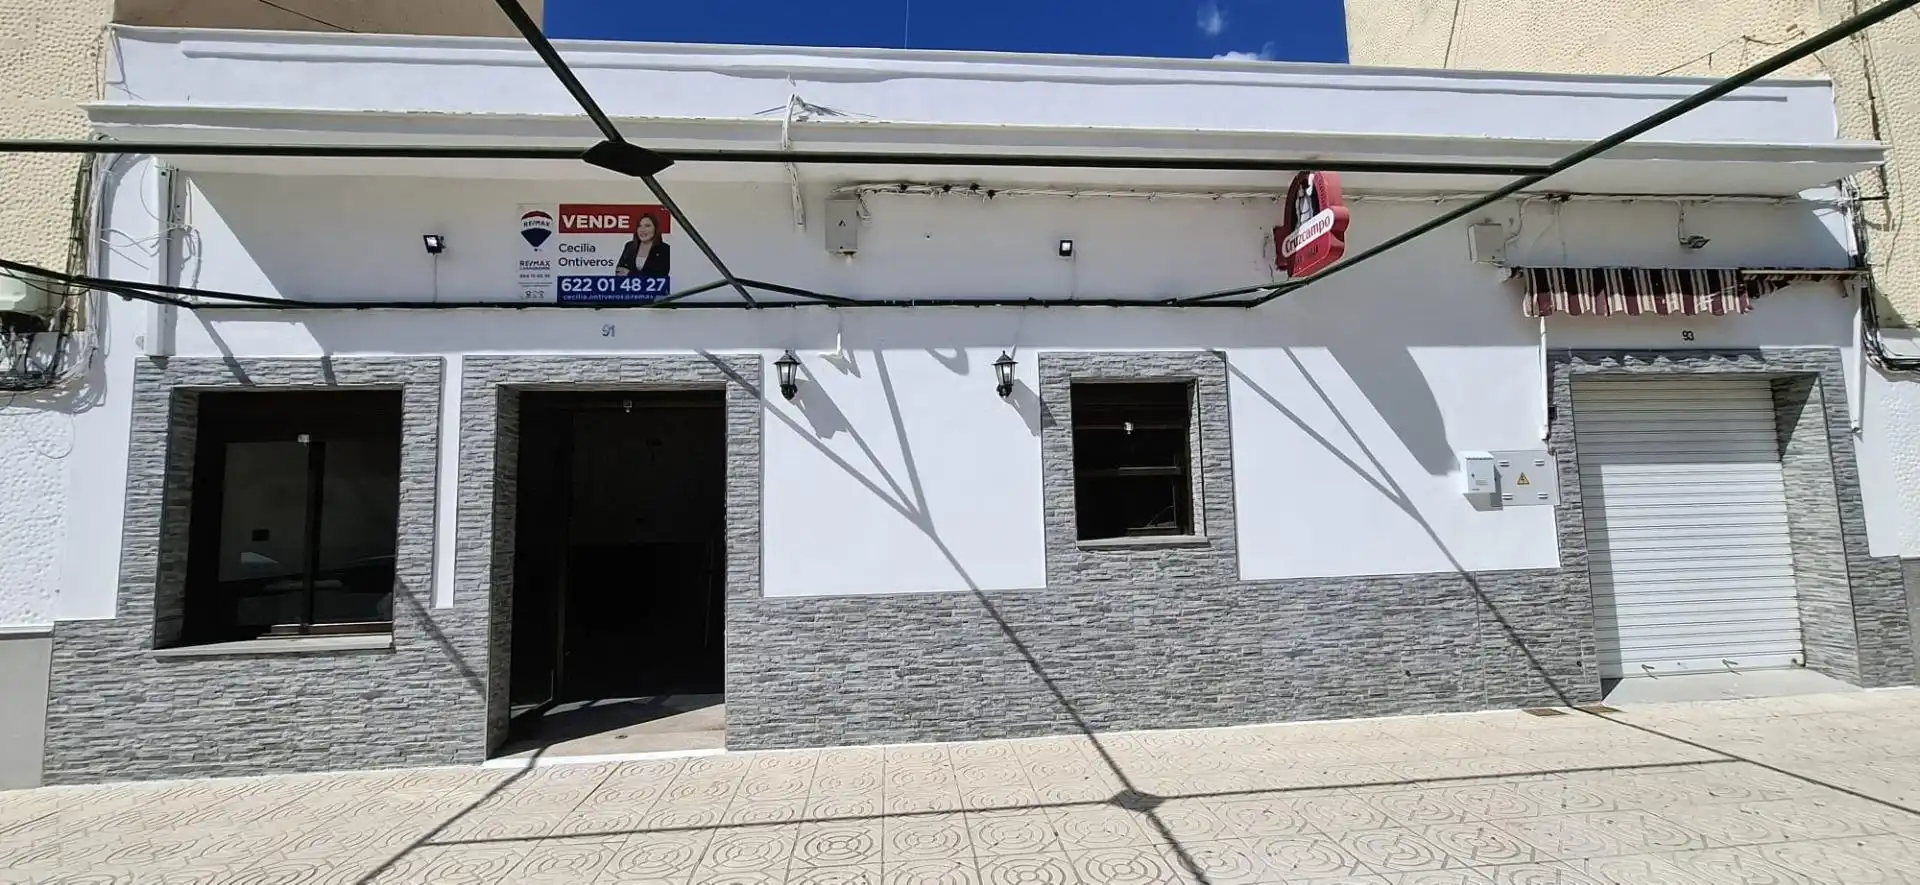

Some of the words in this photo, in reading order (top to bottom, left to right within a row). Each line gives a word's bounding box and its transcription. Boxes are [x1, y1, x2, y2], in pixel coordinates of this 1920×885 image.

[523, 220, 551, 228] RE/MAX
[561, 214, 630, 229] VENDE
[1285, 215, 1331, 253] Cruzcampo
[558, 243, 596, 253] Cecilia
[558, 257, 614, 267] Ontiveros
[561, 278, 593, 292] 622
[597, 278, 616, 292] 01
[620, 278, 642, 292] 48
[646, 278, 666, 292] 27
[601, 323, 616, 337] 91
[1682, 330, 1695, 341] 93
